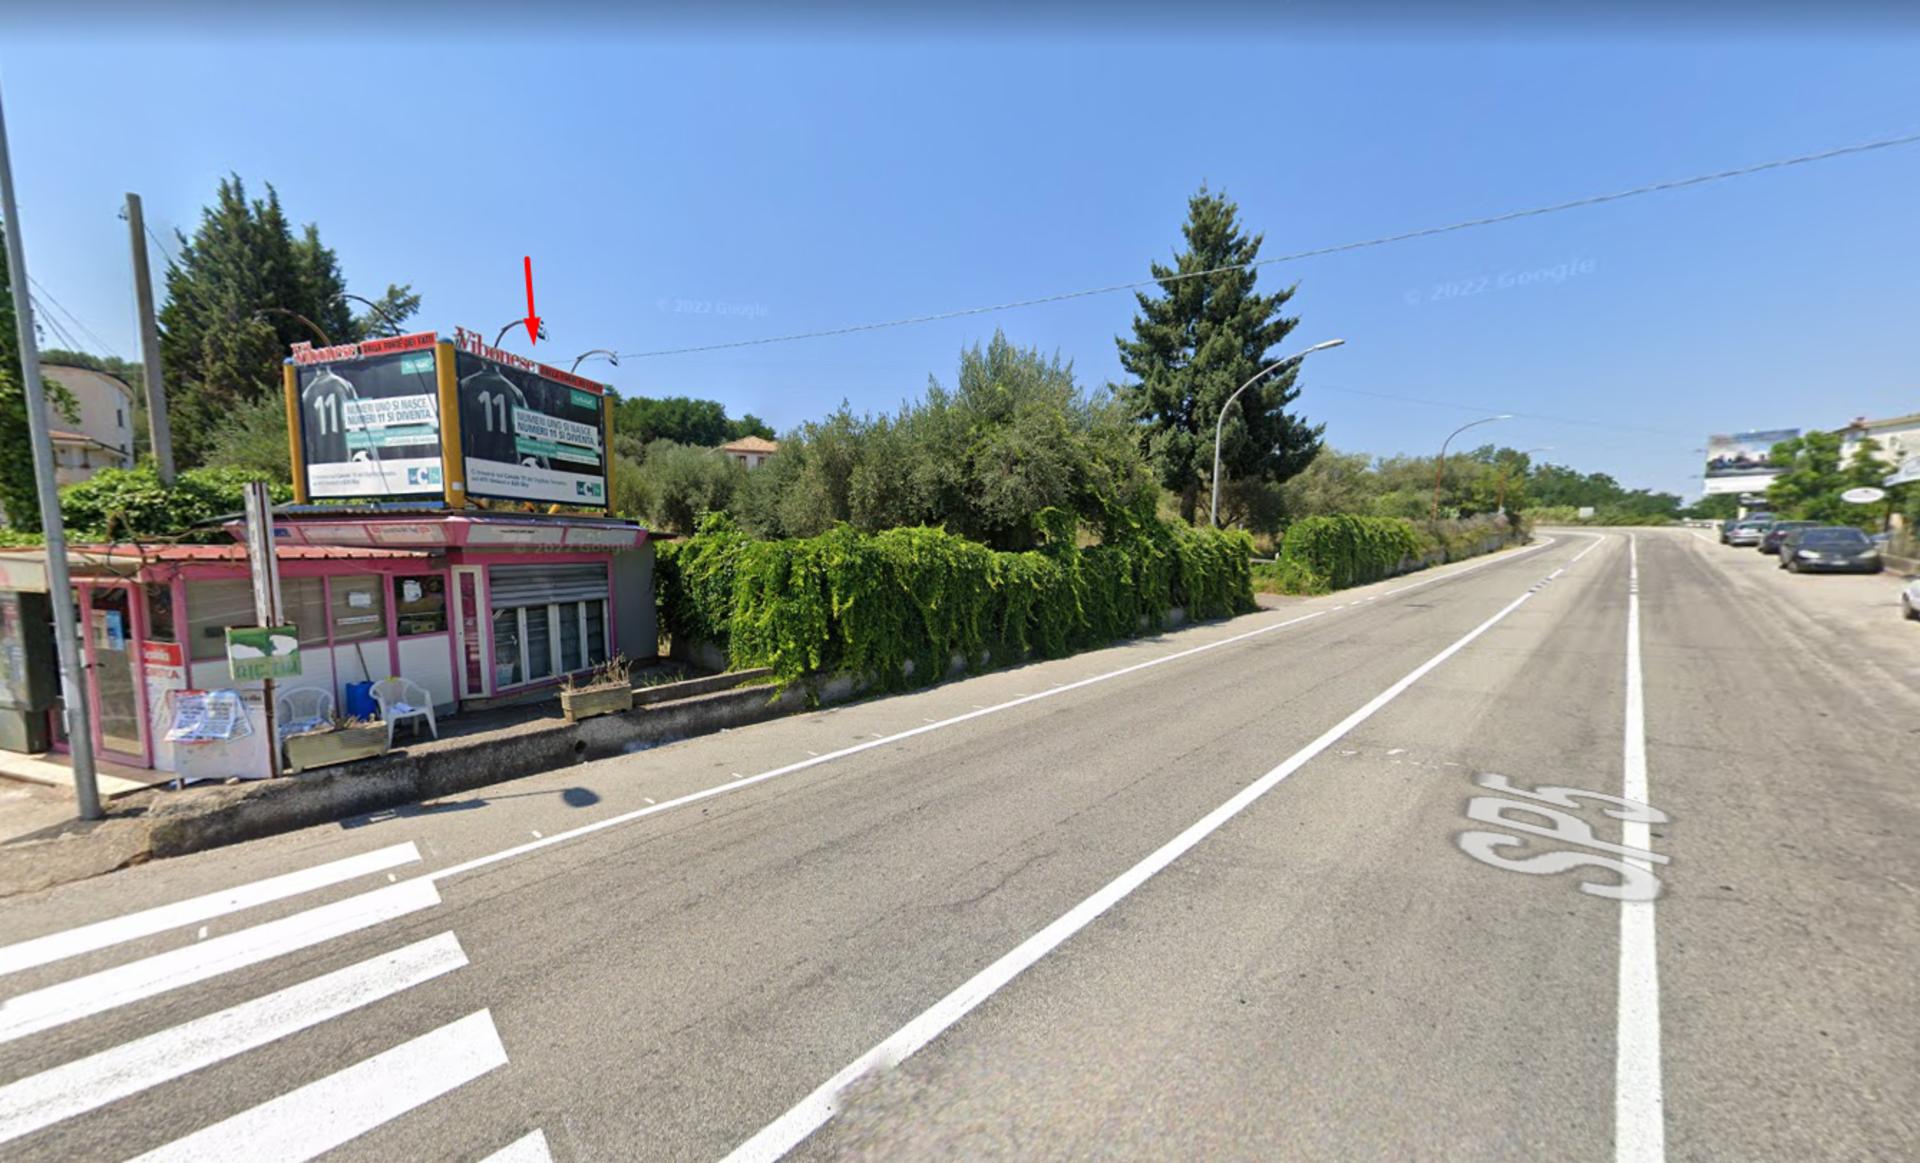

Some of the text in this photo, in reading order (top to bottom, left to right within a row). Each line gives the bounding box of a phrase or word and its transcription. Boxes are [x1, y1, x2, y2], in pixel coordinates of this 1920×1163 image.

[454, 325, 536, 372] Vibonese
[314, 393, 338, 435] 11
[478, 390, 507, 434] 11
